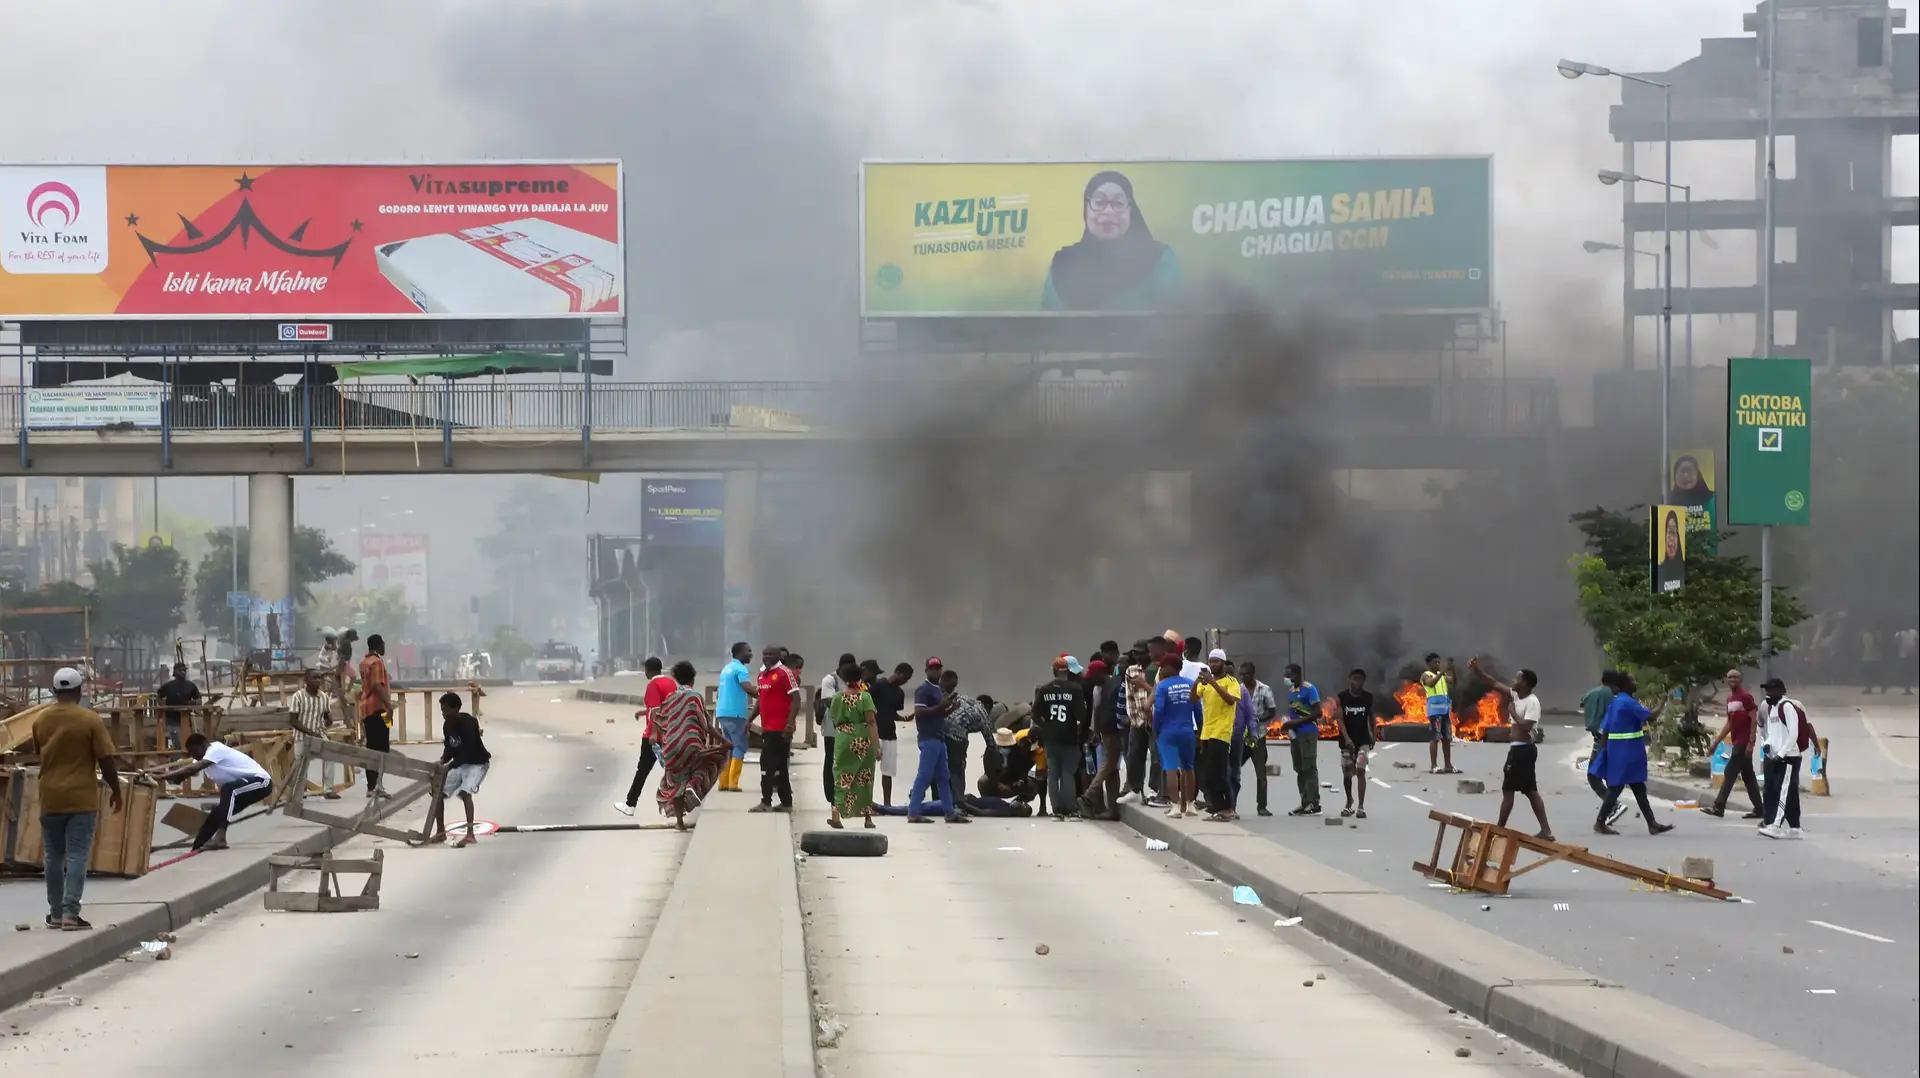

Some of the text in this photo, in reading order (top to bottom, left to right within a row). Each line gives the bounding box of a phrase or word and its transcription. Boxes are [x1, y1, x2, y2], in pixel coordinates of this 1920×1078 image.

[379, 203, 608, 213] GODORO LENYE VIWANGO VYA DARAJA LA JUU
[914, 197, 996, 227] KAZI NA
[1192, 186, 1434, 234] CHAGUA SAMIA
[976, 208, 1028, 236] UTU
[913, 236, 1025, 256] TUNASONGA MBELE
[1241, 226, 1389, 258] CHAGUA CCM
[9, 251, 21, 260] For
[38, 250, 55, 260] REST
[58, 252, 64, 263] of
[88, 251, 100, 262] life
[162, 270, 328, 294] Ishi kama Mfalme
[1739, 394, 1802, 410] OKTOBA
[1736, 410, 1806, 426] TUNATIKI
[1044, 693, 1056, 701] FEAR
